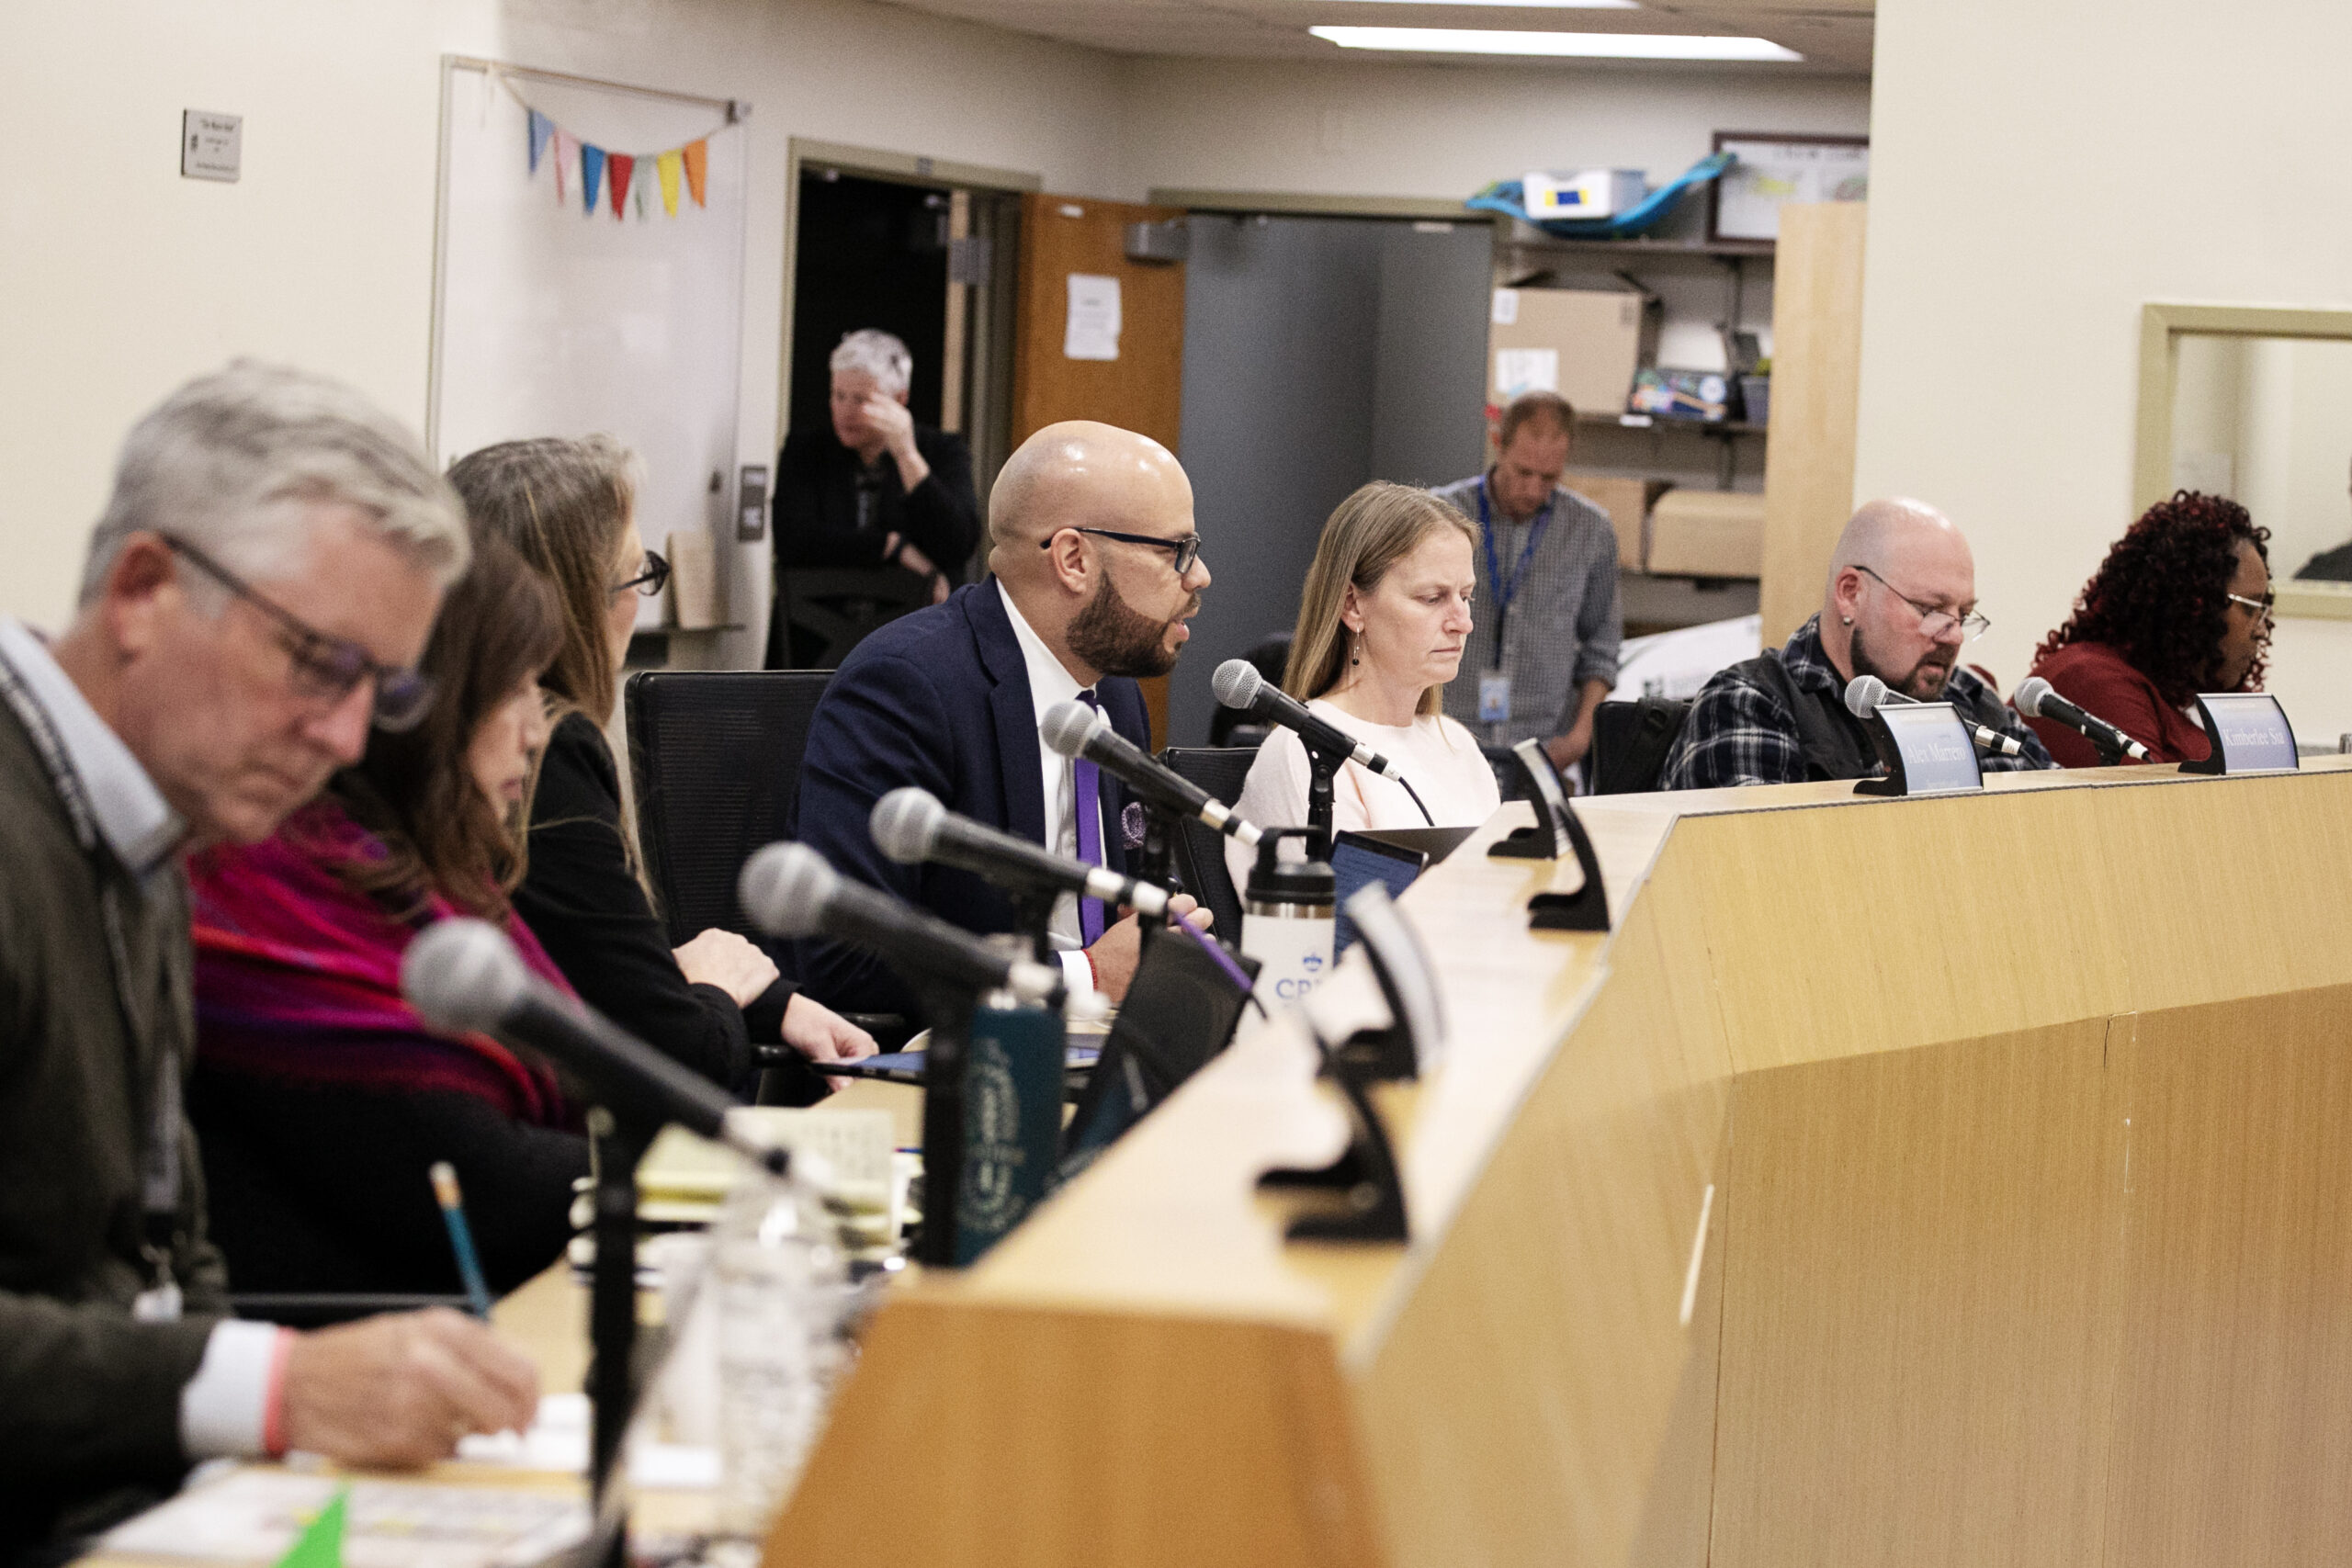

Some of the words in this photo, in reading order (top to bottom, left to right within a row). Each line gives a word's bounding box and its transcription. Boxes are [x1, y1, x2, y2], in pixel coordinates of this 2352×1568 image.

[2222, 728, 2268, 746] Kimberlee
[1907, 743, 1929, 764] Alex
[1928, 742, 1966, 762] Marrero
[1275, 978, 1322, 1000] CP
